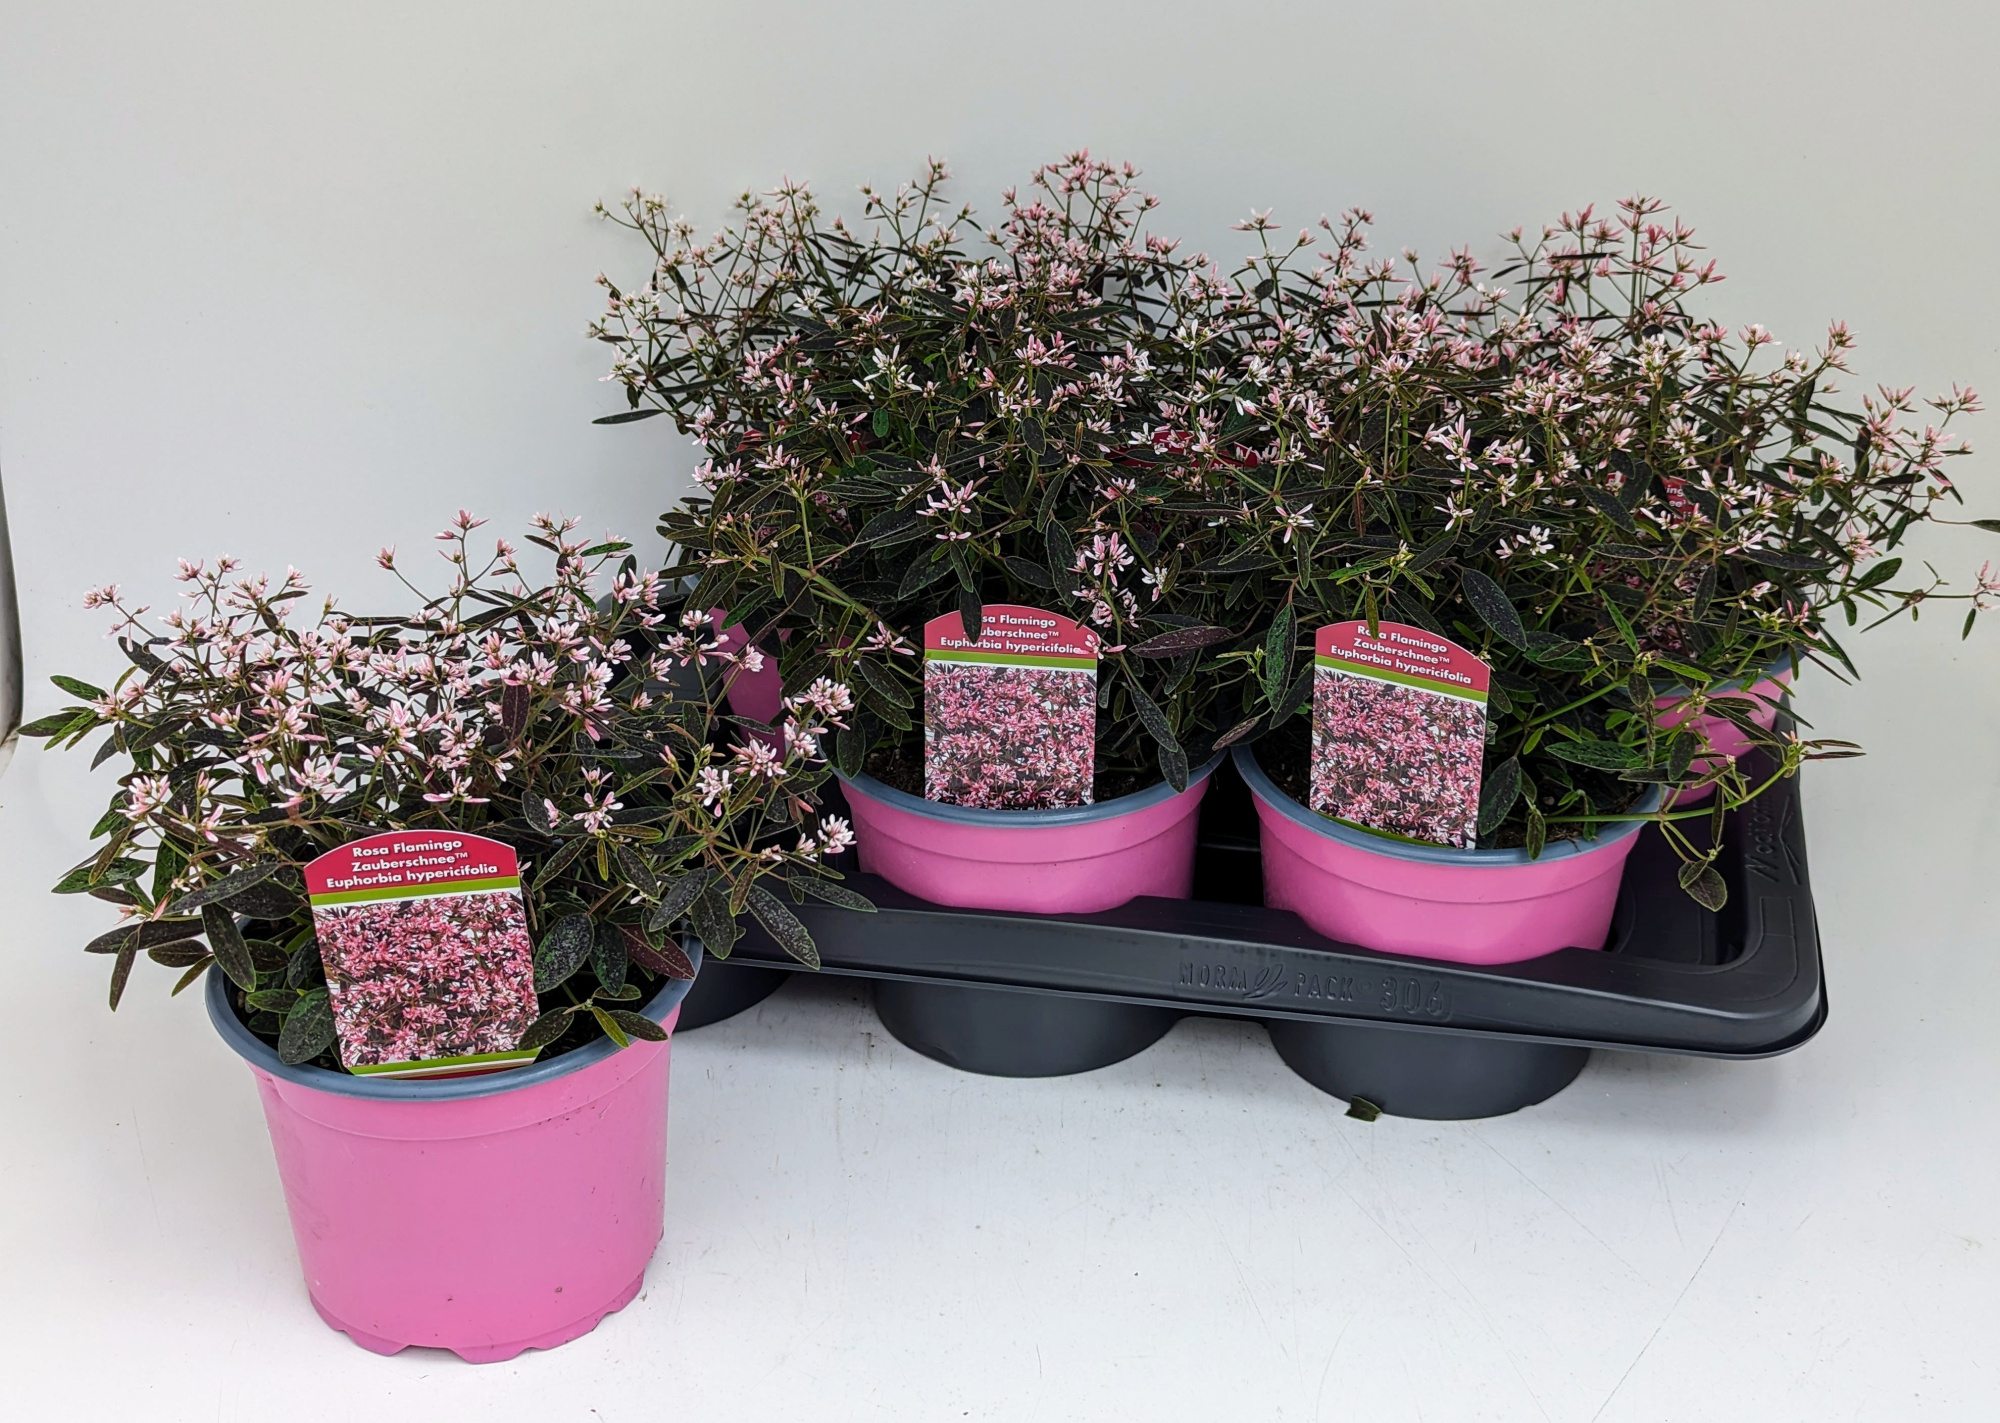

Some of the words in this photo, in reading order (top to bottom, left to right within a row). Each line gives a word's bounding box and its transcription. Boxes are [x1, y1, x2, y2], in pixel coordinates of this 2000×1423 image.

[980, 626, 1059, 640] uberschnee™
[999, 614, 1056, 629] Flamingo
[1357, 625, 1387, 640] Roa
[1390, 632, 1448, 653] Flamingo
[1331, 645, 1392, 667] Euphorbia
[1395, 658, 1472, 685] hypericifolia
[352, 846, 389, 858] Rosa
[393, 839, 463, 855] Flamingo
[326, 872, 403, 889] Euphorbia
[406, 863, 498, 883] hypericifolia
[1178, 962, 1248, 991] NORM
[1379, 976, 1445, 1015] 306
